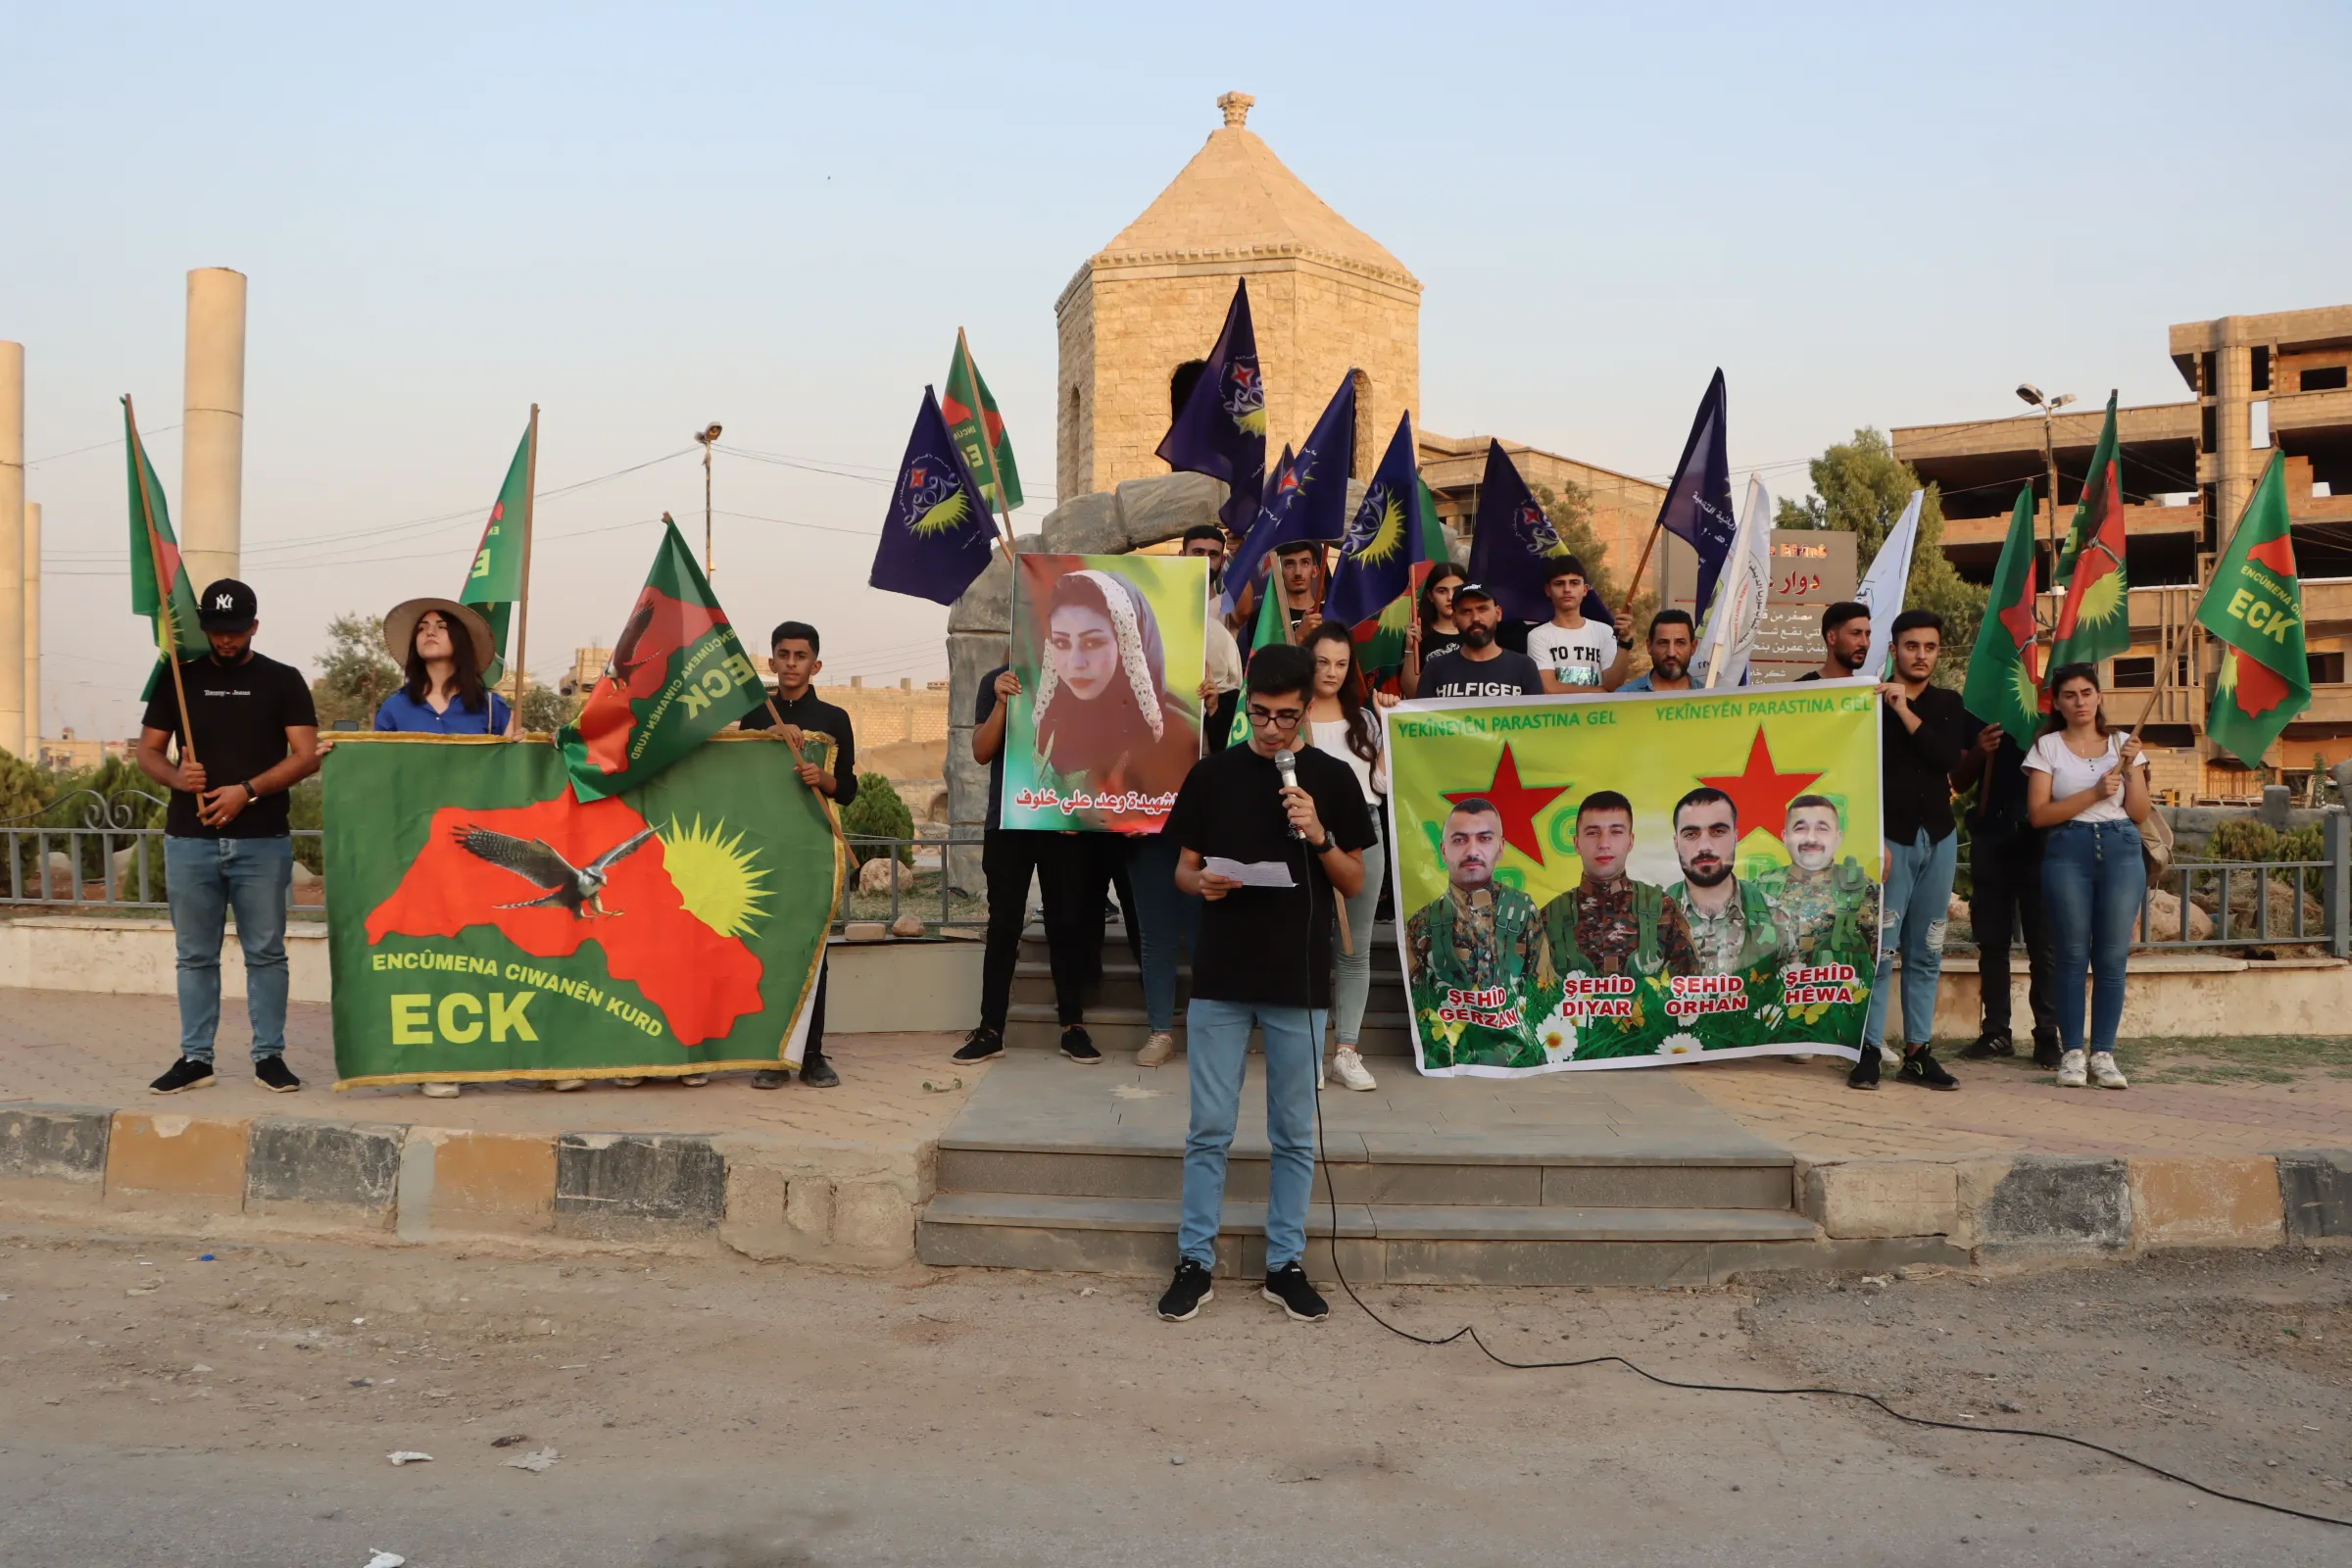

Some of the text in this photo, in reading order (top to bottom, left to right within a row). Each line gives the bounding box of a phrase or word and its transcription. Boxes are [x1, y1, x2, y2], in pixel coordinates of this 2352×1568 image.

[1776, 569, 1821, 596] دوار
[2240, 565, 2292, 606] ENCÛMENA
[216, 594, 233, 611] NY
[1770, 611, 1784, 622] من
[2227, 588, 2299, 644] ECK
[1756, 625, 1823, 640] لتي تقع شم
[1549, 647, 1569, 662] TO
[1772, 641, 1804, 654] عفرين
[1765, 668, 1787, 678] شكر
[1436, 682, 1522, 698] HILFIGER
[1655, 696, 1873, 721] YEKÎNEYÊN PARASTINA GEL
[1398, 710, 1617, 738] YEKÎNEYÊN PARASTINA GEL
[1015, 788, 1059, 810] خلوف
[1060, 789, 1093, 814] علي
[1094, 792, 1127, 813] وعد
[1672, 973, 1743, 997] ŞEHÎD
[1785, 962, 1854, 988] ŞEHÎD
[372, 949, 662, 1038] ENCÛMENA CIWANÊN KURD
[1448, 987, 1506, 1007] ŞEHÎD
[1564, 975, 1635, 999] ŞEHÎD
[1785, 985, 1853, 1004] HÊWA
[1562, 1000, 1632, 1017] DIYAR
[1666, 996, 1748, 1015] ORHAN
[390, 991, 539, 1046] ECK
[1439, 1007, 1518, 1029] GERZAN
